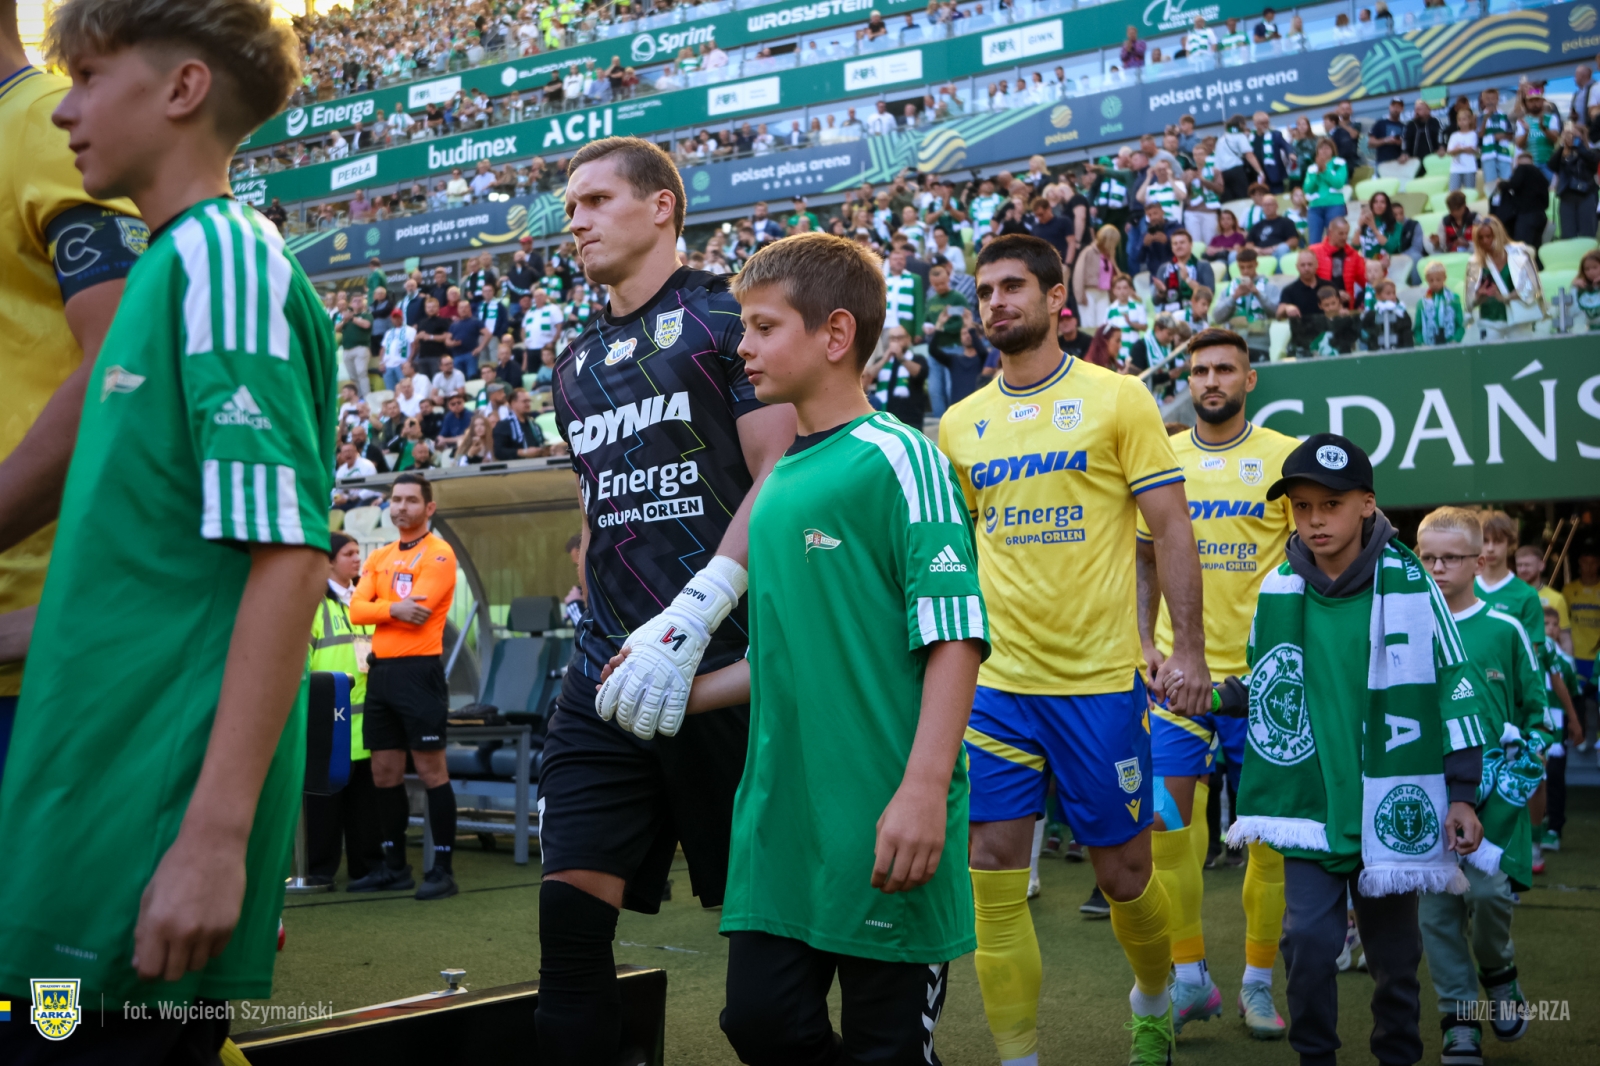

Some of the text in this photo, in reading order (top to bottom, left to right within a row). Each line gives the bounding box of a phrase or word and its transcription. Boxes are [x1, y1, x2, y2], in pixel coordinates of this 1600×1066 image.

[747, 0, 873, 32] WROSYSTEM
[657, 25, 716, 53] Sprint
[1562, 35, 1600, 53] polsa
[1150, 68, 1298, 111] polsat plus arena
[311, 99, 374, 128] Energa
[543, 108, 613, 148] ACH
[1045, 130, 1078, 146] polsat
[428, 136, 518, 169] budimex
[337, 163, 372, 182] PERŁA
[731, 154, 851, 186] polsat plus arena
[395, 213, 489, 241] polsat plus arena
[329, 252, 351, 264] polsat
[612, 343, 632, 359] LOTTO
[214, 411, 271, 430] adidas
[568, 391, 691, 457] GDYNIA
[1014, 407, 1034, 418] LOTTO
[598, 460, 699, 500] Energa
[971, 450, 1087, 490] GDYNIA
[598, 499, 699, 528] GRUPA ORLEN
[1004, 505, 1083, 528] Energa
[1005, 530, 1083, 546] GRUPA ORLEN
[1197, 539, 1257, 559] Energa
[929, 562, 967, 573] adidas
[1227, 562, 1256, 571] ORLEN
[1381, 787, 1404, 810] TYLKO
